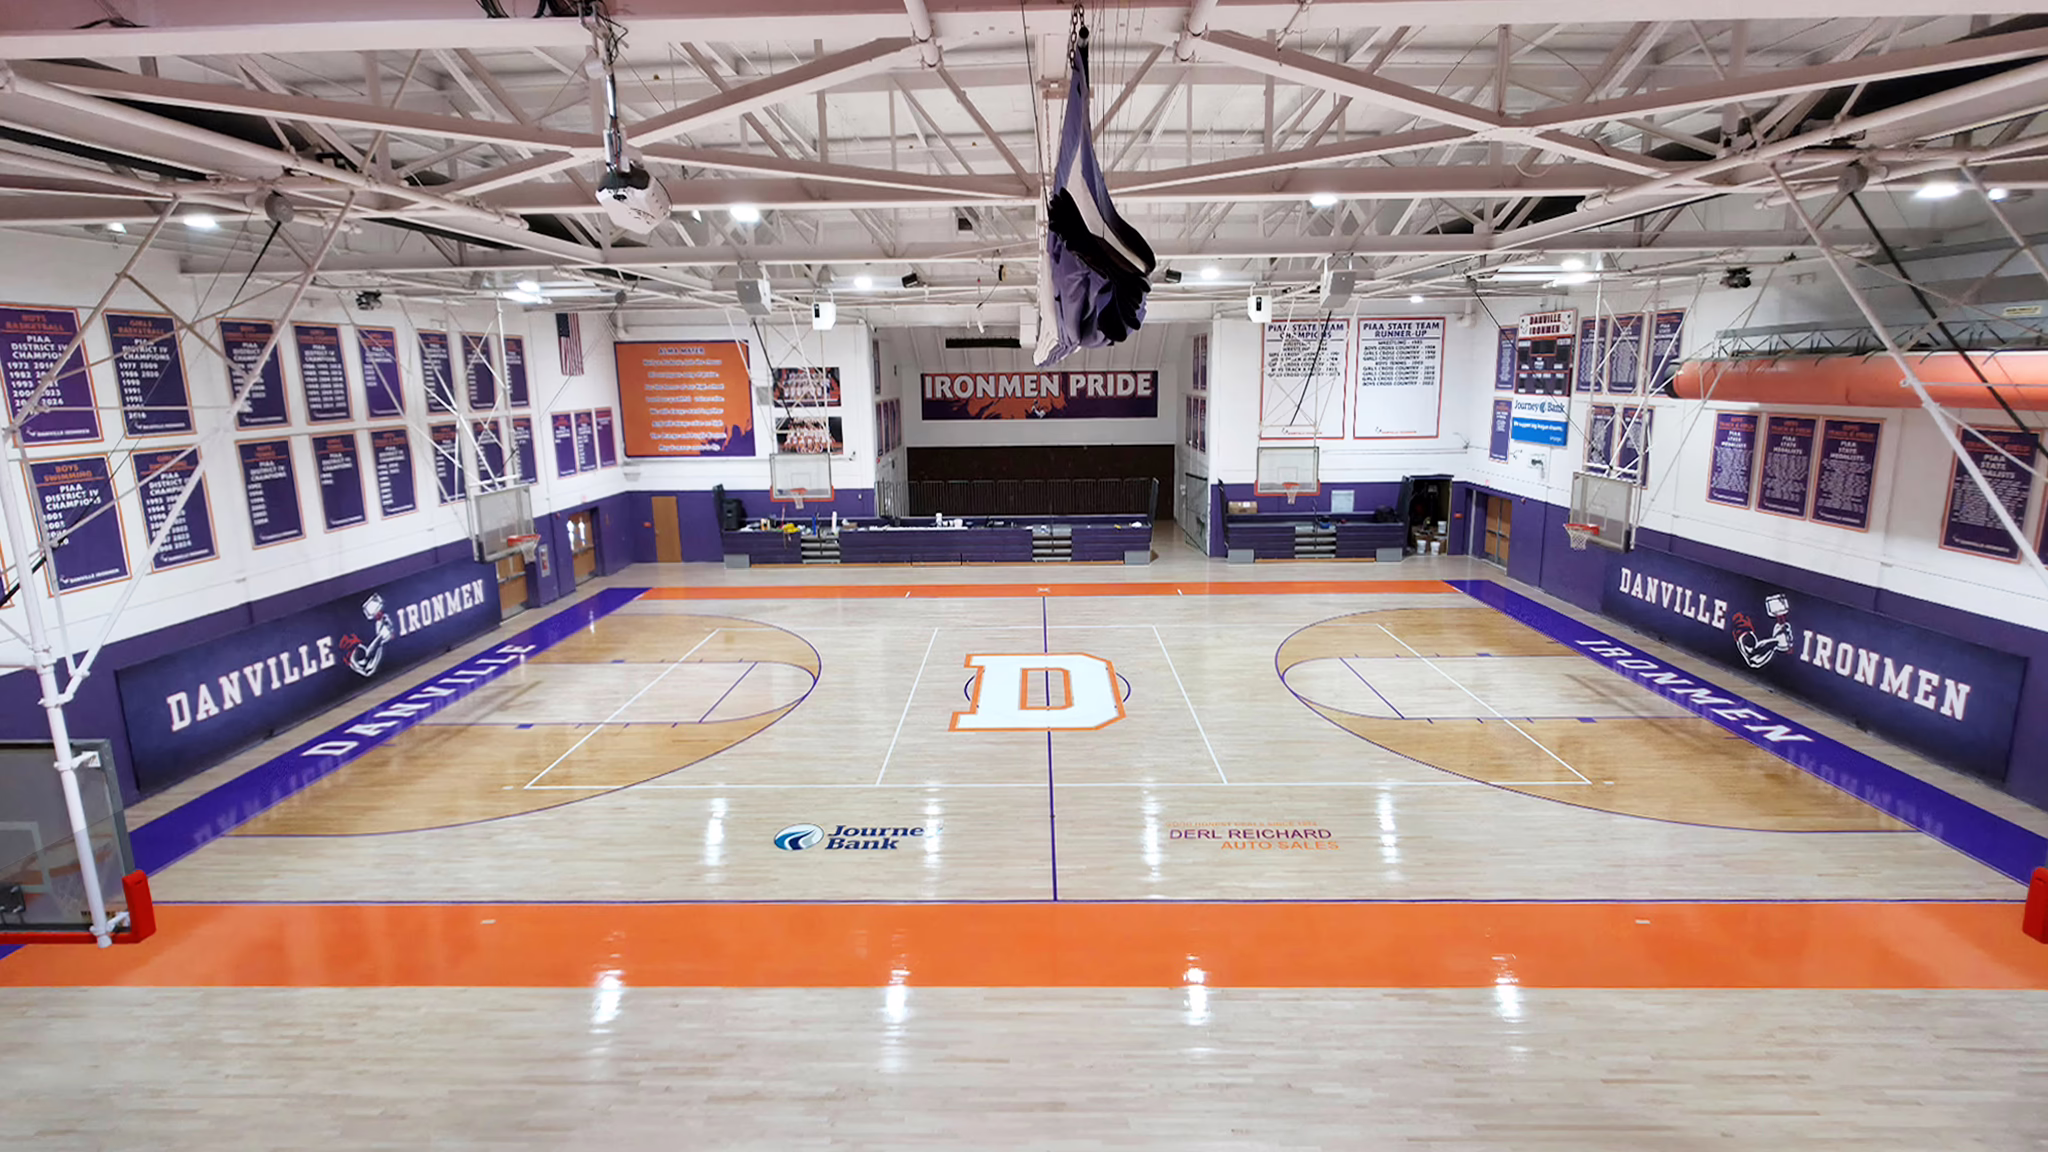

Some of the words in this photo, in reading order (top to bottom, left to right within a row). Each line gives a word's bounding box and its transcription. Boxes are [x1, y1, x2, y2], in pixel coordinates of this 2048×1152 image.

[1530, 314, 1561, 325] DANVILLE
[1529, 325, 1560, 335] IRONMEN
[26, 335, 51, 343] PIAA
[11, 343, 54, 351] DISTRICT
[12, 352, 62, 360] CHAMPIO
[924, 374, 1060, 398] IRONMEN
[1069, 373, 1153, 398] PRIDE
[1515, 400, 1539, 412] Journey
[1547, 402, 1565, 413] Bank
[56, 464, 79, 472] BOYS
[44, 471, 93, 482] SWIMMING
[1980, 470, 2015, 479] DALISTS
[59, 484, 83, 493] PIAA
[45, 491, 86, 503] DISTRICT
[1619, 568, 1728, 631] DANVILLE
[1800, 630, 1971, 722] IRONMEN
[166, 636, 336, 732] DANVILLE
[396, 578, 484, 636] IRONMEN
[948, 652, 1126, 732] D
[1576, 639, 1814, 744] IRONMEN
[301, 644, 536, 757] DANVILLE
[828, 825, 934, 838] Journe
[1170, 829, 1222, 839] DERL
[1228, 829, 1332, 839] REICHARD
[825, 838, 899, 850] Bank
[1221, 841, 1272, 850] AUTO
[1278, 841, 1340, 850] SALES
